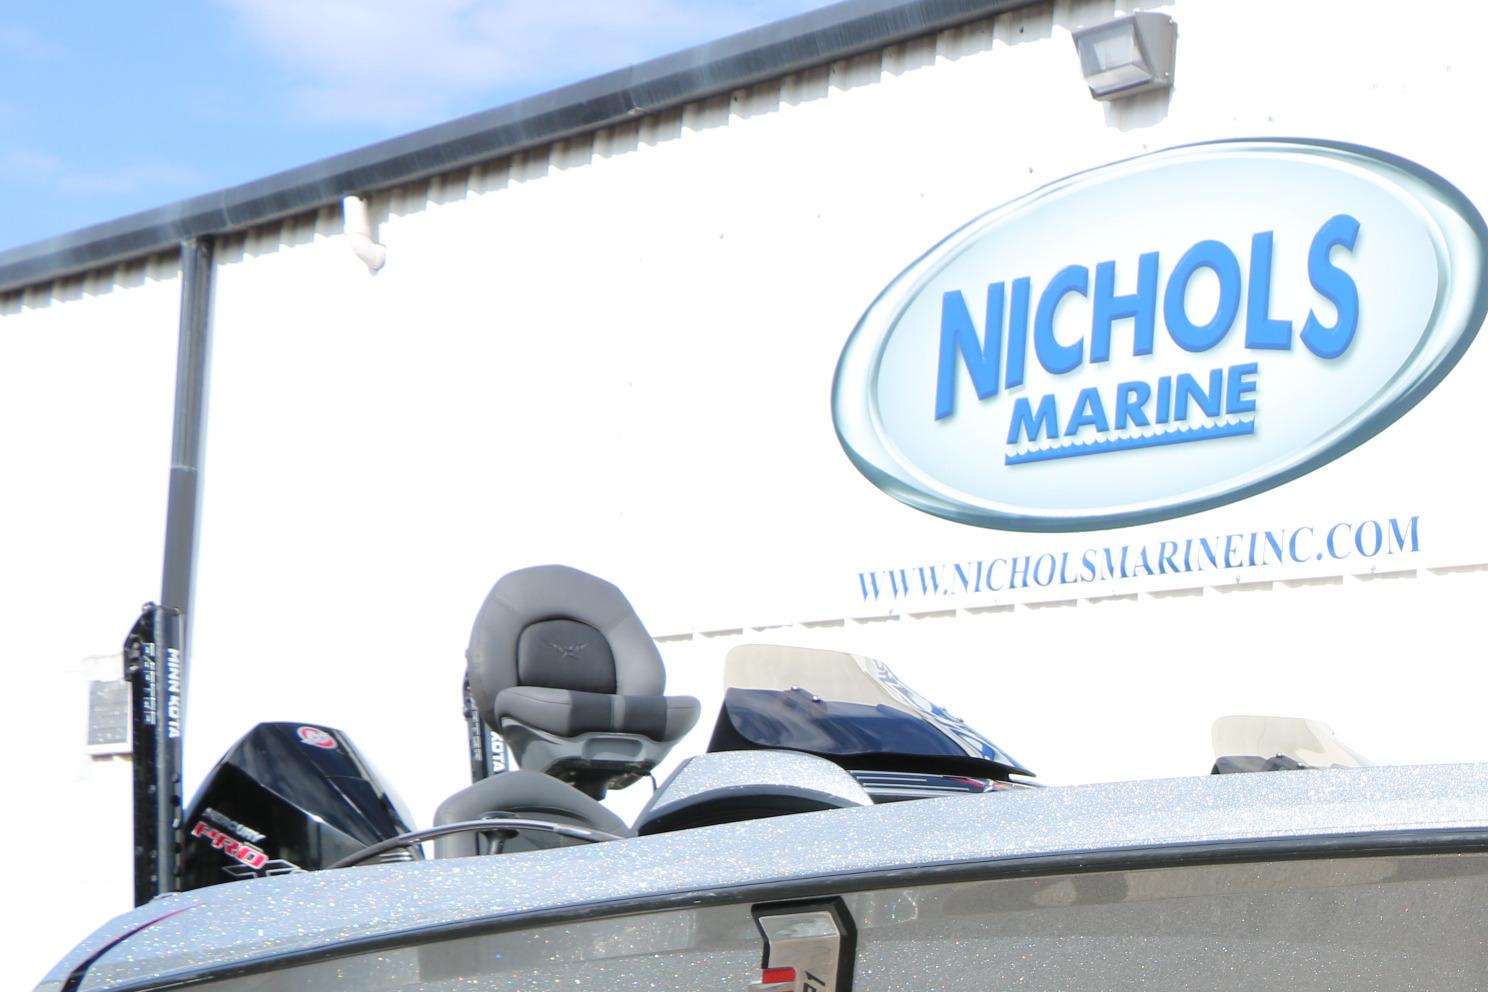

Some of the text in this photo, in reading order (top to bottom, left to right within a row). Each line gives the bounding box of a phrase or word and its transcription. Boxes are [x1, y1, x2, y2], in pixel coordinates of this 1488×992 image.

[934, 213, 1361, 422] NICHOLS
[1006, 362, 1259, 445] MARINE
[857, 515, 1422, 602] WWW.NICHOLSMARINEINC.COM
[167, 647, 181, 738] MINN KOTA
